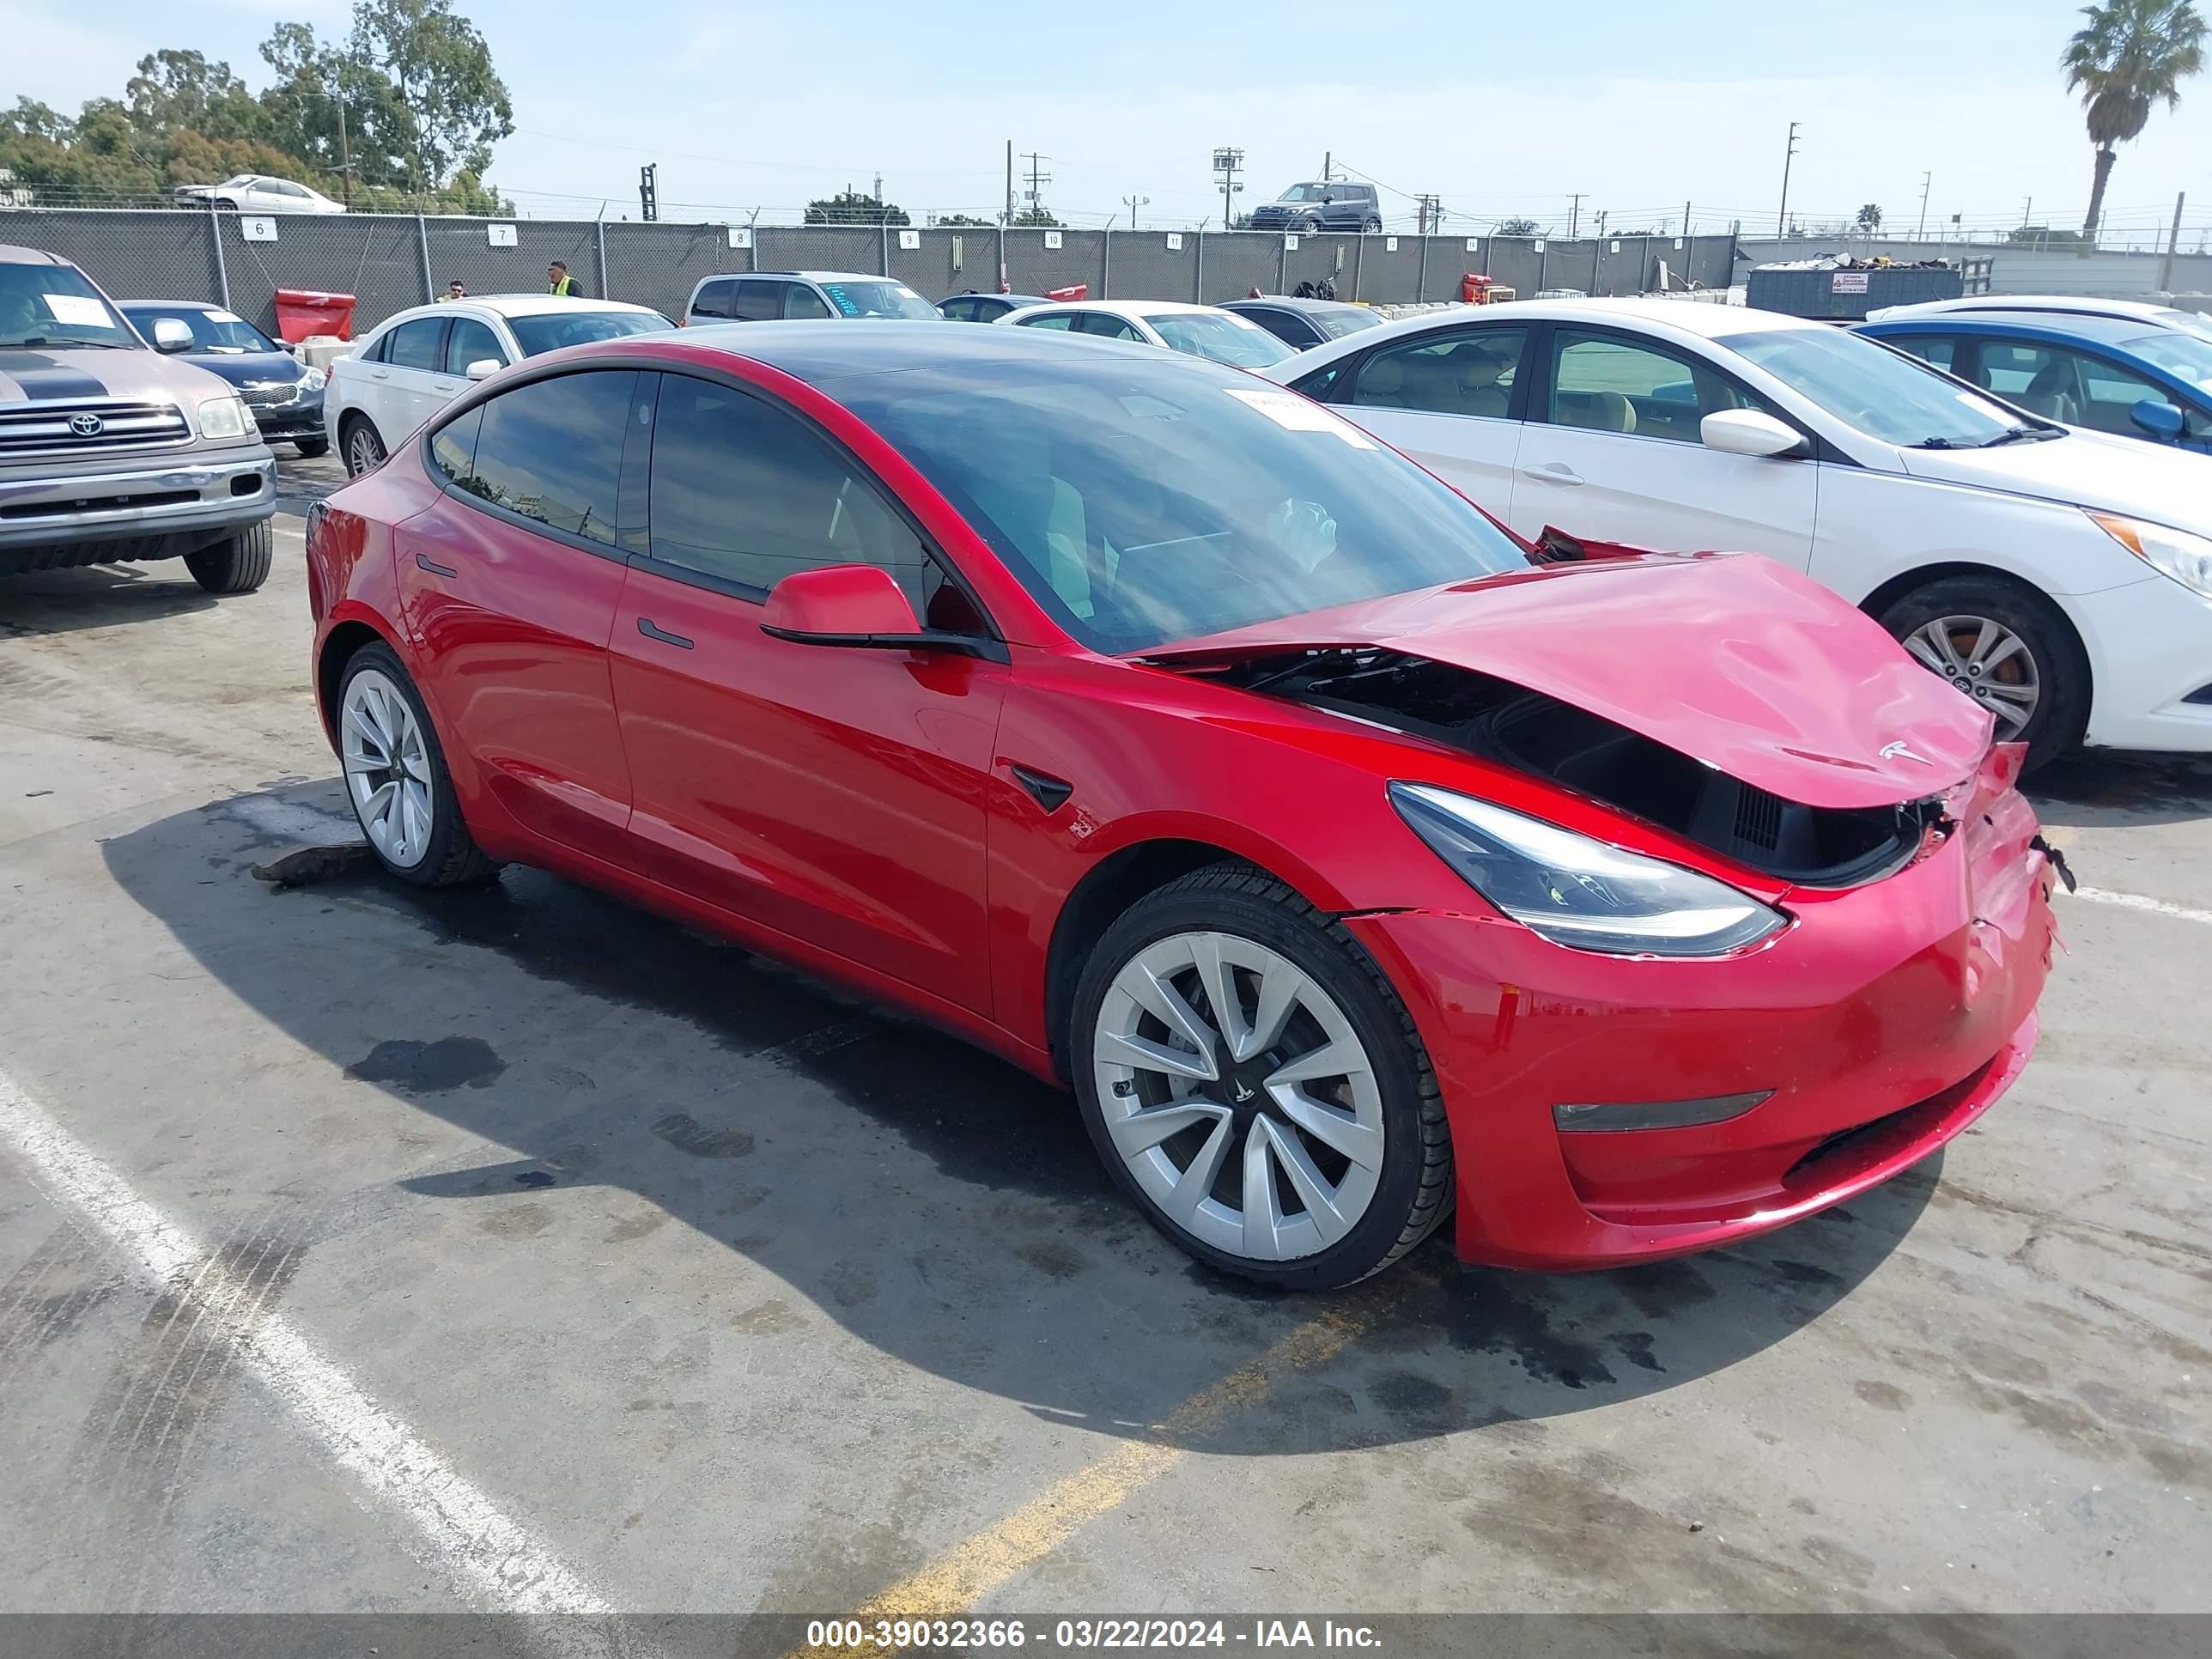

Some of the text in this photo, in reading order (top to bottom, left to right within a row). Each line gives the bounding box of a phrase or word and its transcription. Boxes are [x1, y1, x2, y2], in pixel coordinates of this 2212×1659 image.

[255, 222, 264, 234] 6
[498, 229, 506, 240] 7
[737, 233, 744, 243] 8
[906, 235, 913, 245] 9
[1049, 235, 1058, 245] 10
